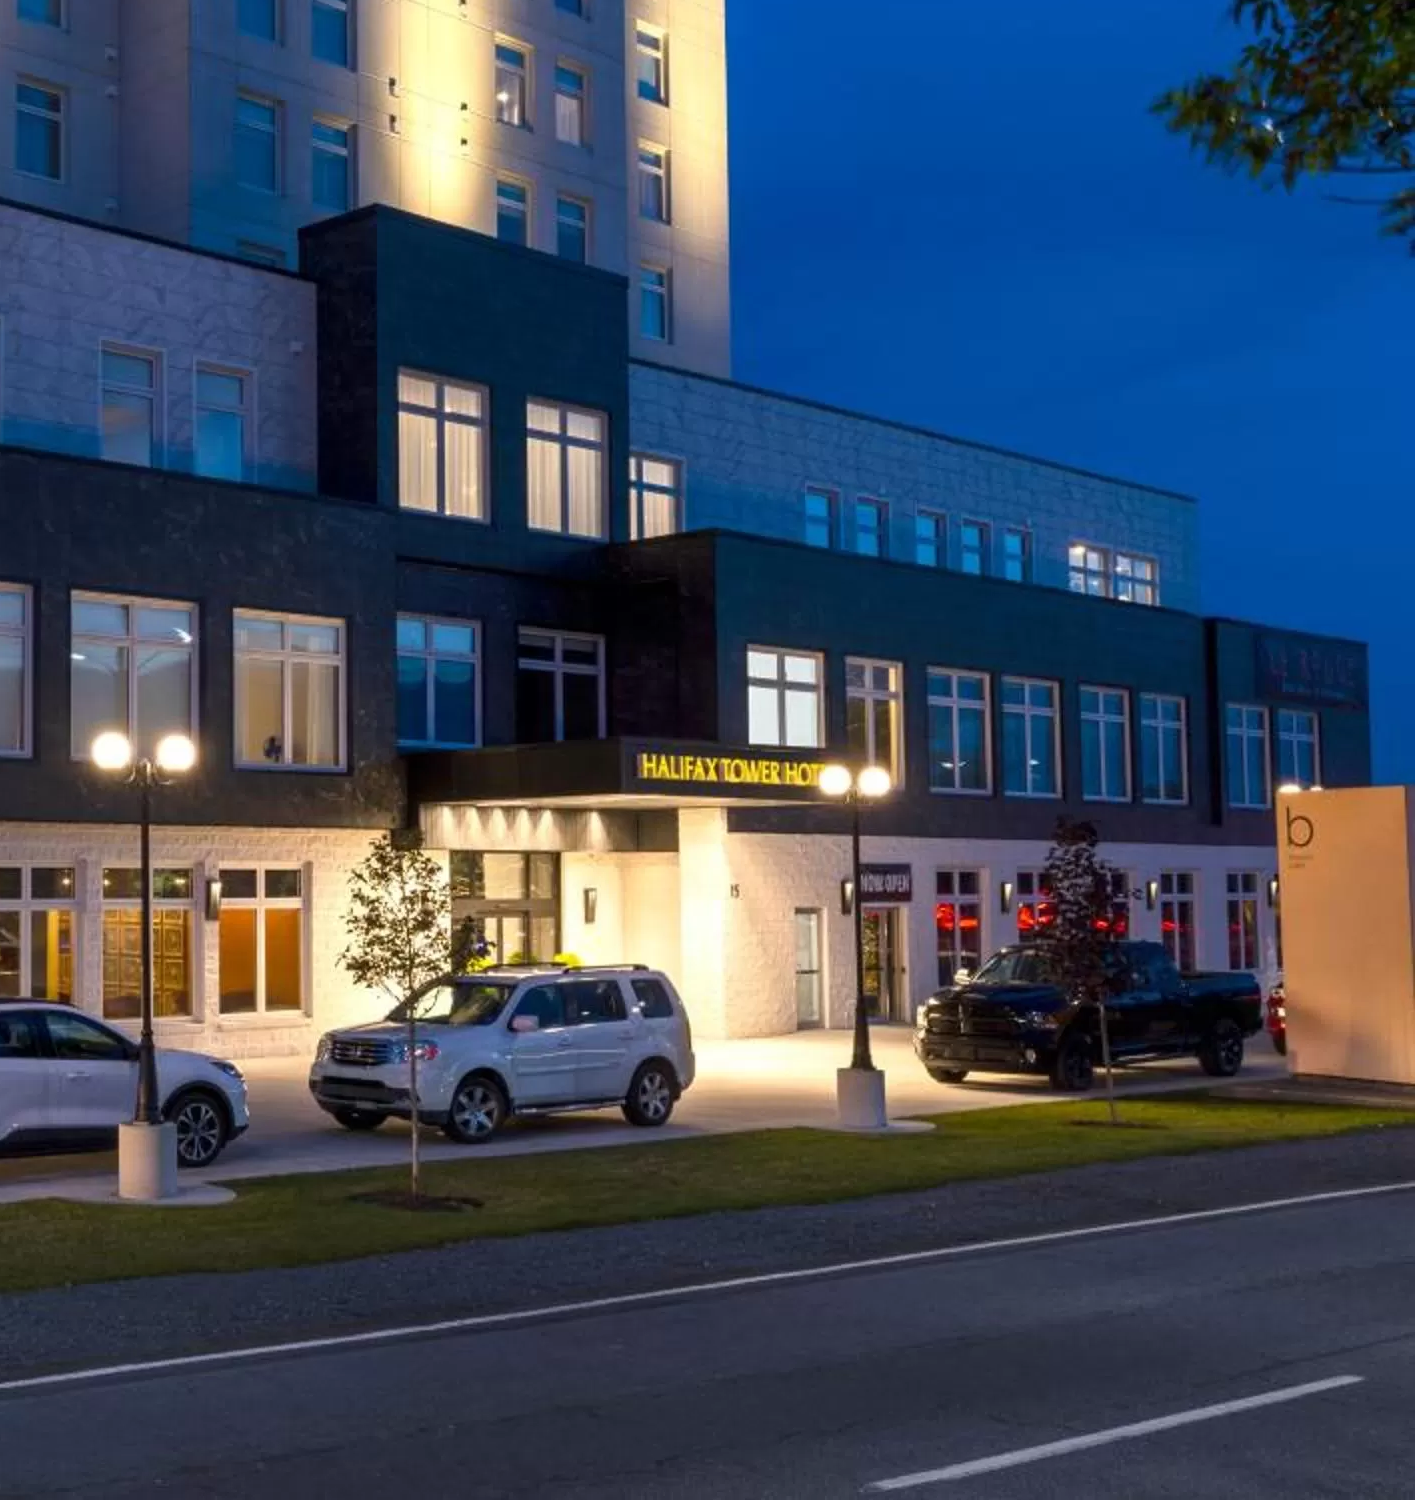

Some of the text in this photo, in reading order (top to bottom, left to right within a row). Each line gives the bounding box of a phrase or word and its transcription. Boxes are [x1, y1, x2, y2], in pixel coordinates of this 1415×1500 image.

[641, 752, 826, 787] HALIFAX TOWER HOT
[1286, 805, 1314, 847] b
[730, 884, 740, 899] 15
[860, 873, 910, 892] NOW OPEN
